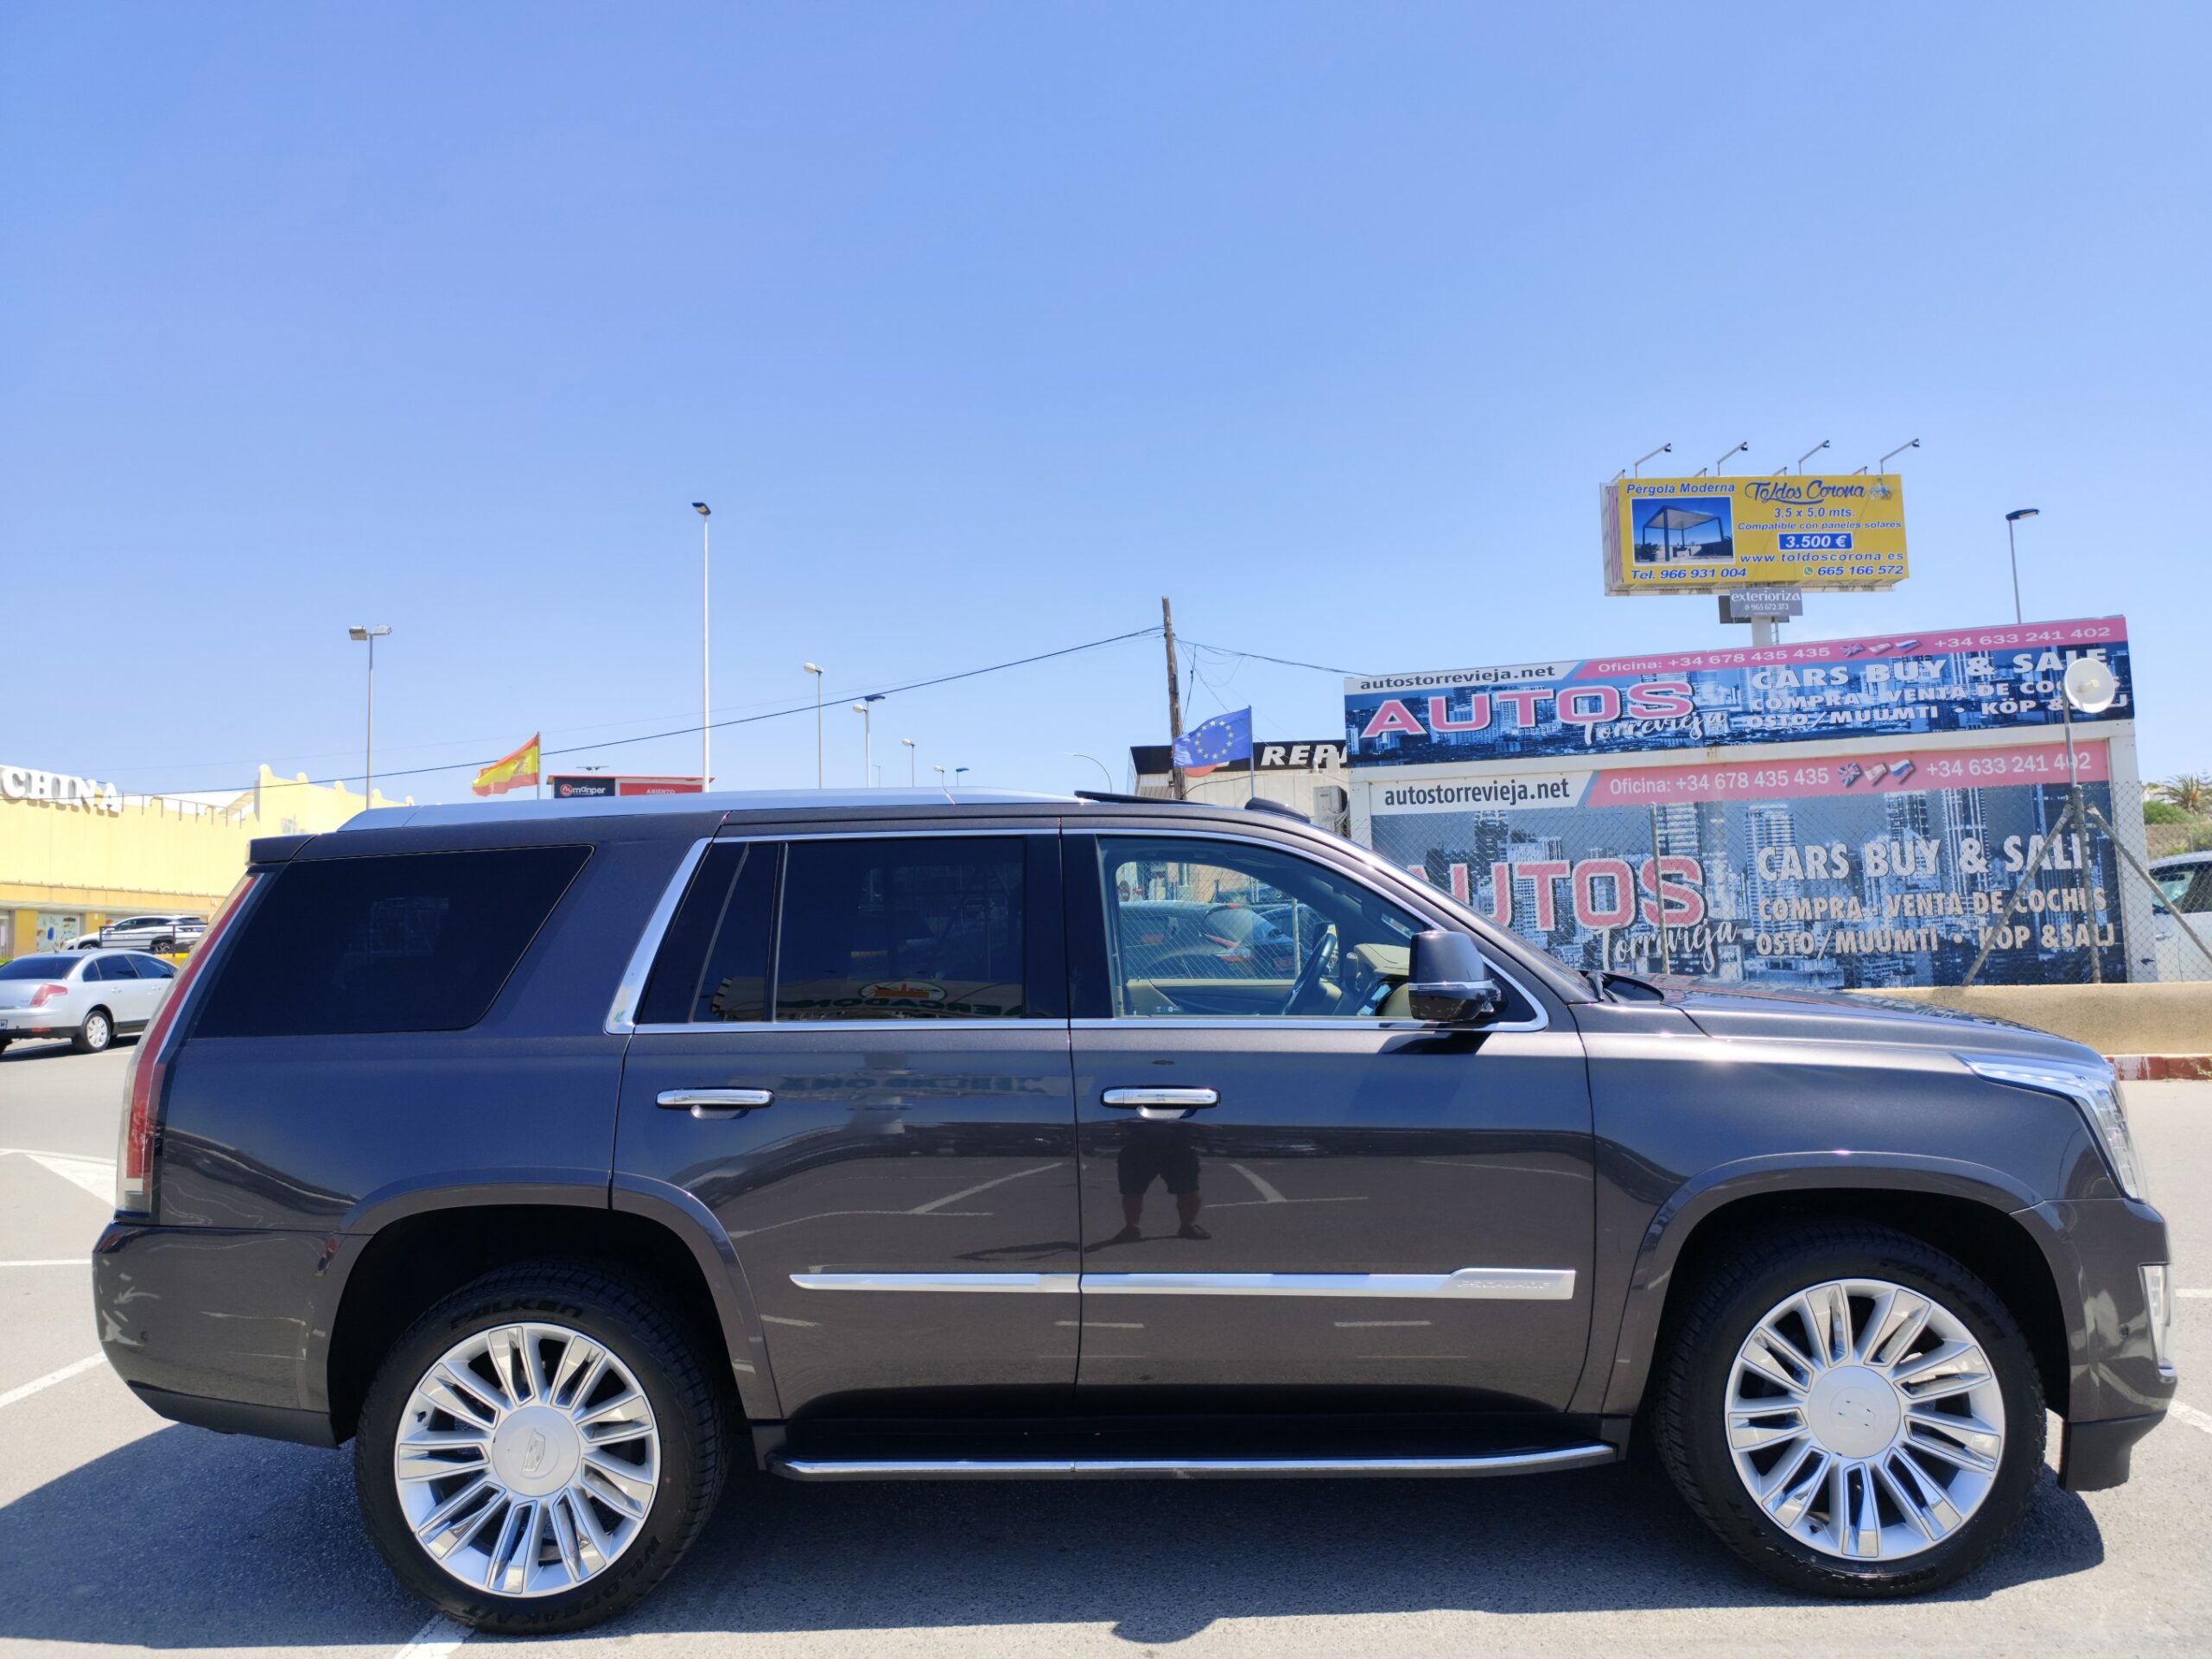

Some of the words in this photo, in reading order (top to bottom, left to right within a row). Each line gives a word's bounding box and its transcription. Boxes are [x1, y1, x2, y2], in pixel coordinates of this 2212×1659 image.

[1680, 482, 1735, 493] Moderna
[1745, 480, 1802, 505] Toldos
[1807, 480, 1866, 499] Corona
[1738, 522, 1796, 531] Compatible
[1821, 521, 1861, 531] paneles
[1864, 520, 1902, 530] solares
[1785, 535, 1831, 549] 3.500
[1834, 534, 1847, 547] €
[1740, 552, 1904, 563] www.toldoscorona.es
[1817, 567, 1845, 576] 665
[1848, 566, 1874, 575] 166
[1878, 565, 1904, 575] 572
[1631, 569, 1656, 580] Tel.
[1660, 569, 1688, 580] 966
[1690, 568, 1716, 579] 931
[1720, 567, 1747, 578] 004
[1731, 589, 1801, 602] exterioriza
[1598, 659, 1663, 673] Oficina:
[1668, 656, 1703, 667] +34
[1708, 653, 1745, 664] 678
[1751, 650, 1788, 663] 435
[1793, 647, 1830, 659] 435
[1935, 637, 1973, 649] +34
[1980, 632, 2018, 645] 633
[2026, 631, 2064, 643] 241
[2071, 626, 2111, 639] 402
[1360, 664, 1556, 690] autostorrevieja.net
[1751, 665, 1850, 690] CARS
[1866, 658, 1948, 683] BUY
[1966, 657, 1996, 677] &
[1359, 681, 1695, 740] AUTOS
[1751, 694, 1860, 712] COMPRA
[1887, 683, 1967, 703] VENTA
[1978, 683, 2009, 697] DE
[1980, 698, 2037, 715] KÖP
[1582, 709, 1729, 746] Torrevieja
[1, 766, 121, 813] CHINA
[1610, 777, 1671, 796] Oficina:
[1675, 774, 1709, 792] +34
[1715, 772, 1749, 791] 678
[1754, 770, 1789, 789] 435
[1793, 767, 1830, 787] 435
[1926, 760, 1963, 778] +34
[1968, 757, 2006, 775] 633
[2012, 754, 2050, 772] 241
[1384, 778, 1571, 807] autostorrevieja.net
[1757, 842, 1851, 881] CARS
[1866, 838, 1942, 877] BUY
[1958, 836, 1990, 875] &
[1408, 855, 1709, 931] UTOS
[1758, 896, 1864, 922] COMPRA
[1885, 891, 1964, 918] VENTA
[1973, 892, 2005, 915] DE
